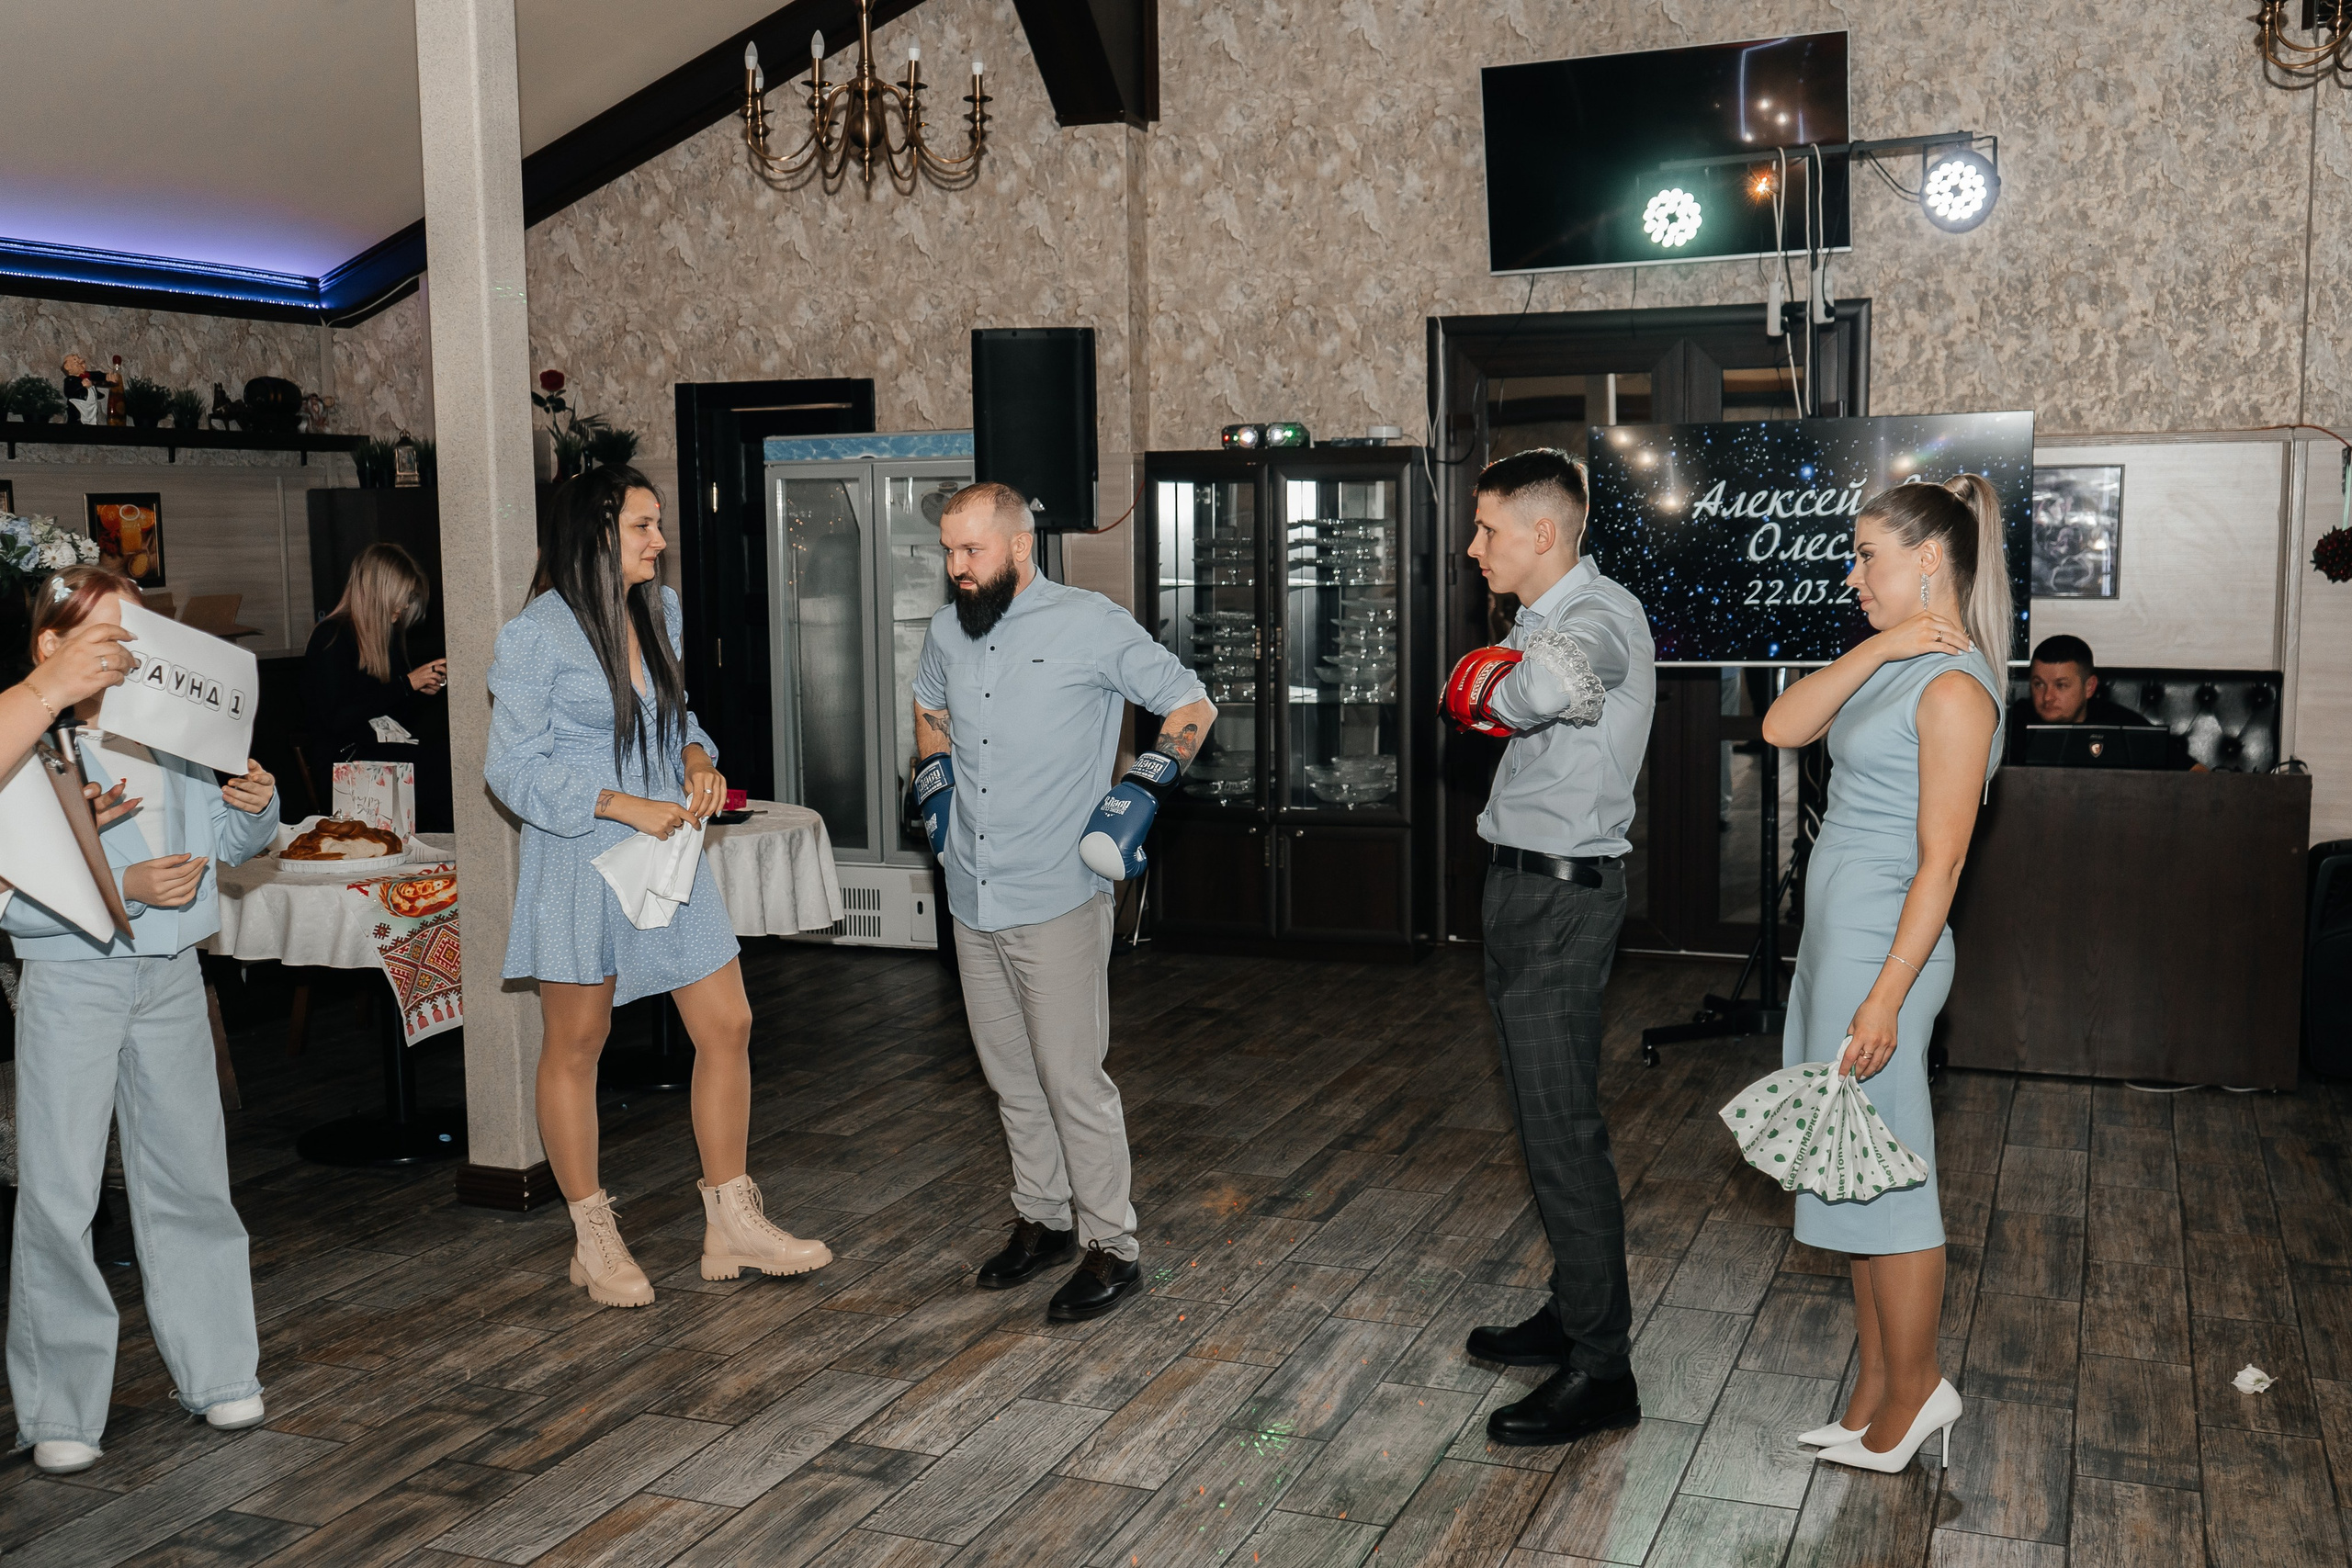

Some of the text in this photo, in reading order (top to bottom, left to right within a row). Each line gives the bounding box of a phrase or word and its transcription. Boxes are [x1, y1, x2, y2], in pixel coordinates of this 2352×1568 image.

[1691, 477, 1867, 519] Алексей
[1747, 522, 1856, 562] Олес
[1744, 579, 1854, 605] 22.03.2
[231, 695, 240, 715] 1
